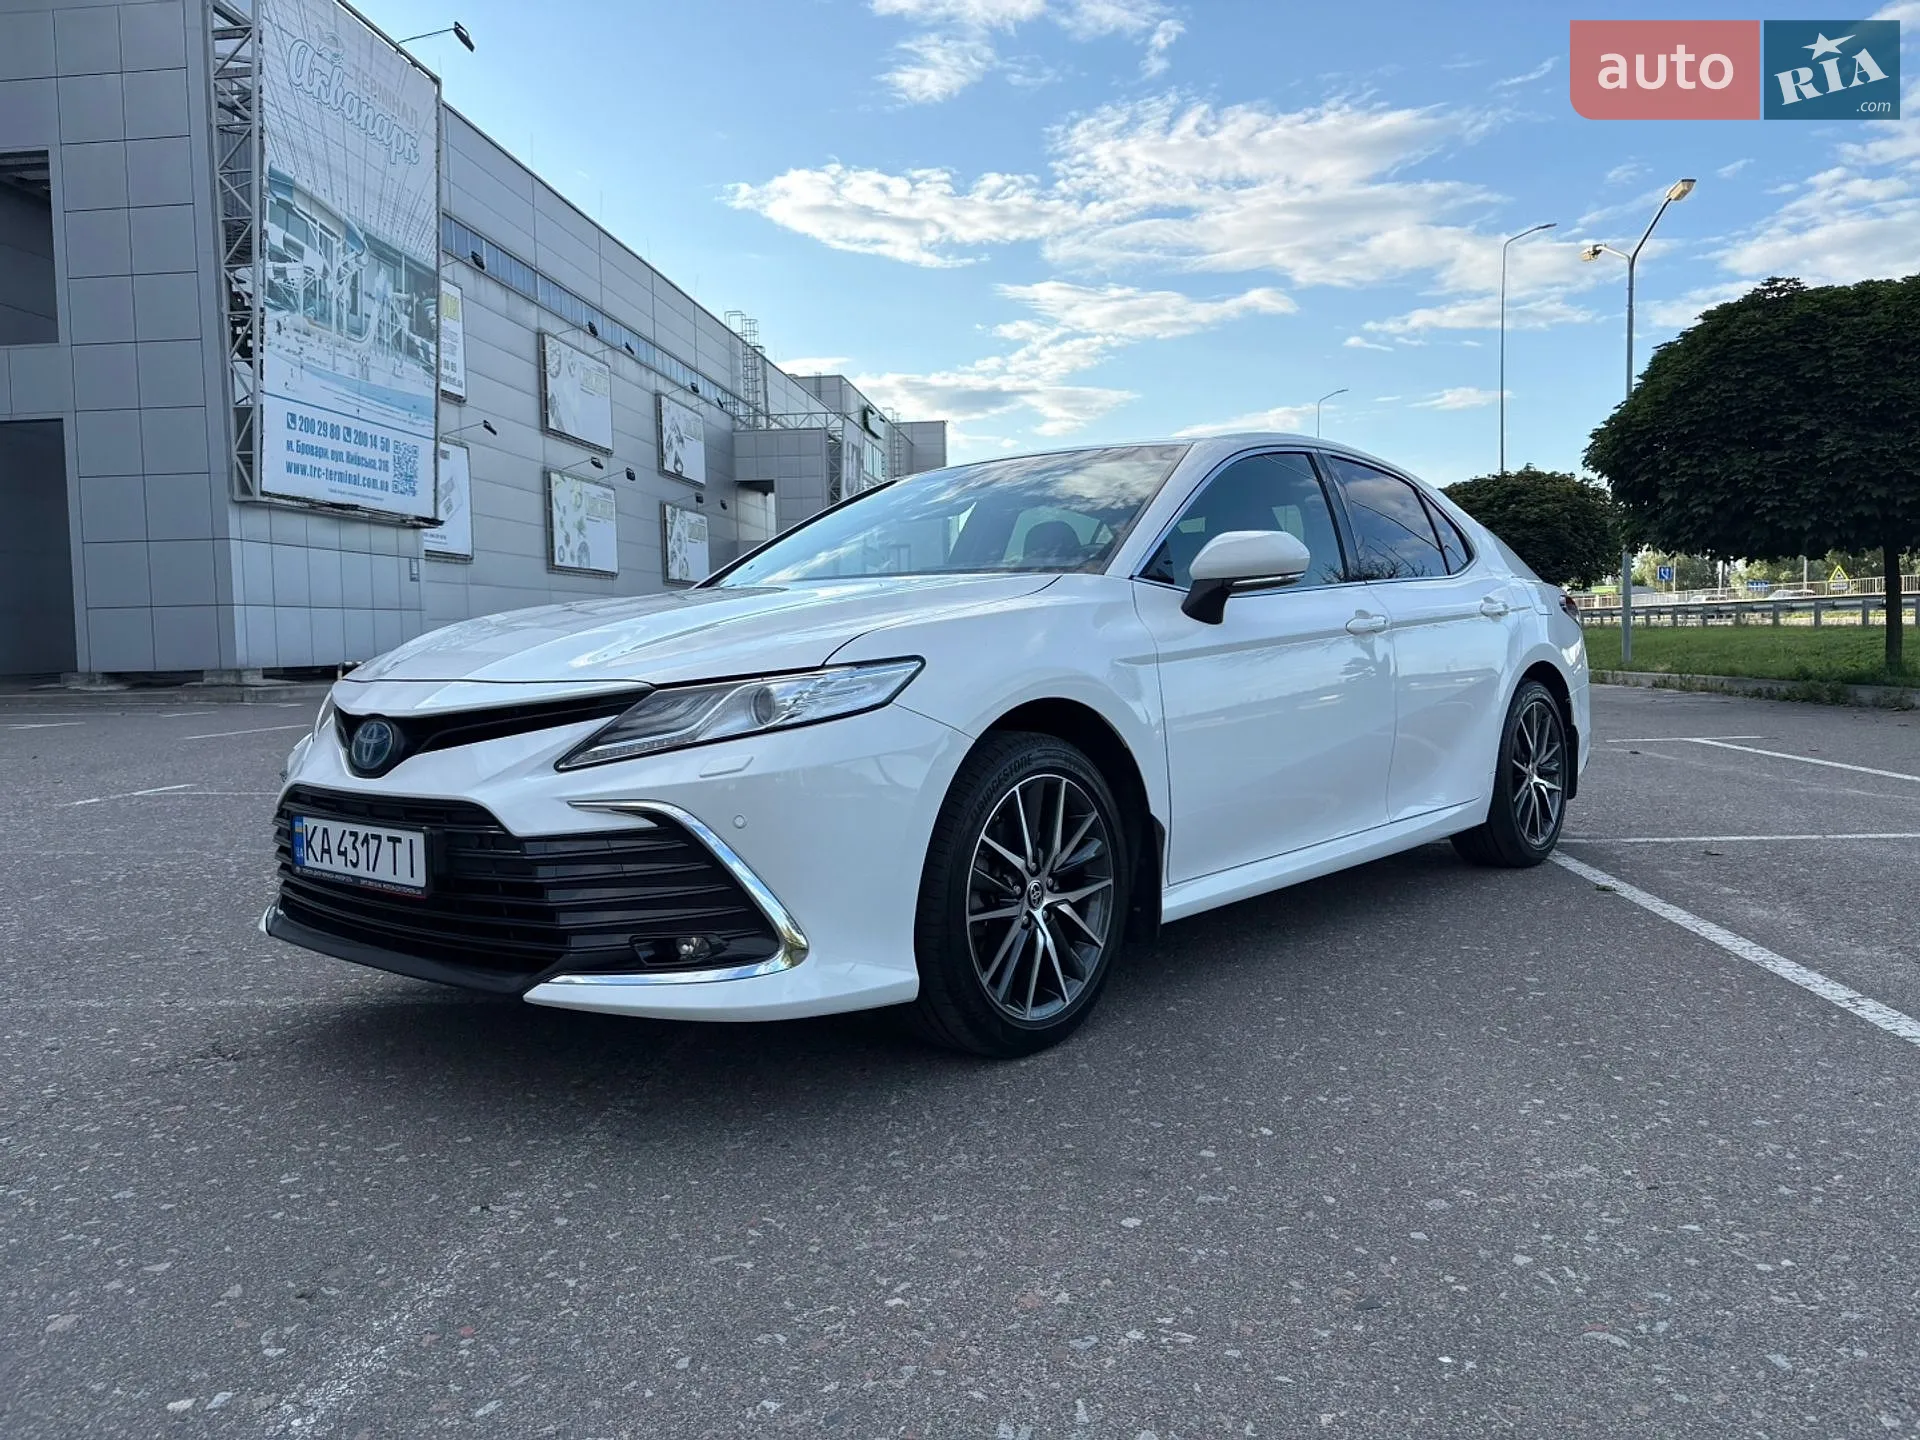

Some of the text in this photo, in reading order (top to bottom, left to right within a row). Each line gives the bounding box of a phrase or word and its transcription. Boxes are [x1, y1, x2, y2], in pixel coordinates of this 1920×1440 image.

[298, 415, 391, 453] 200 29 80 200 14 50
[285, 460, 390, 492] www.trc-terminal.com.ua
[305, 824, 333, 864] KA
[337, 829, 383, 872] 4317
